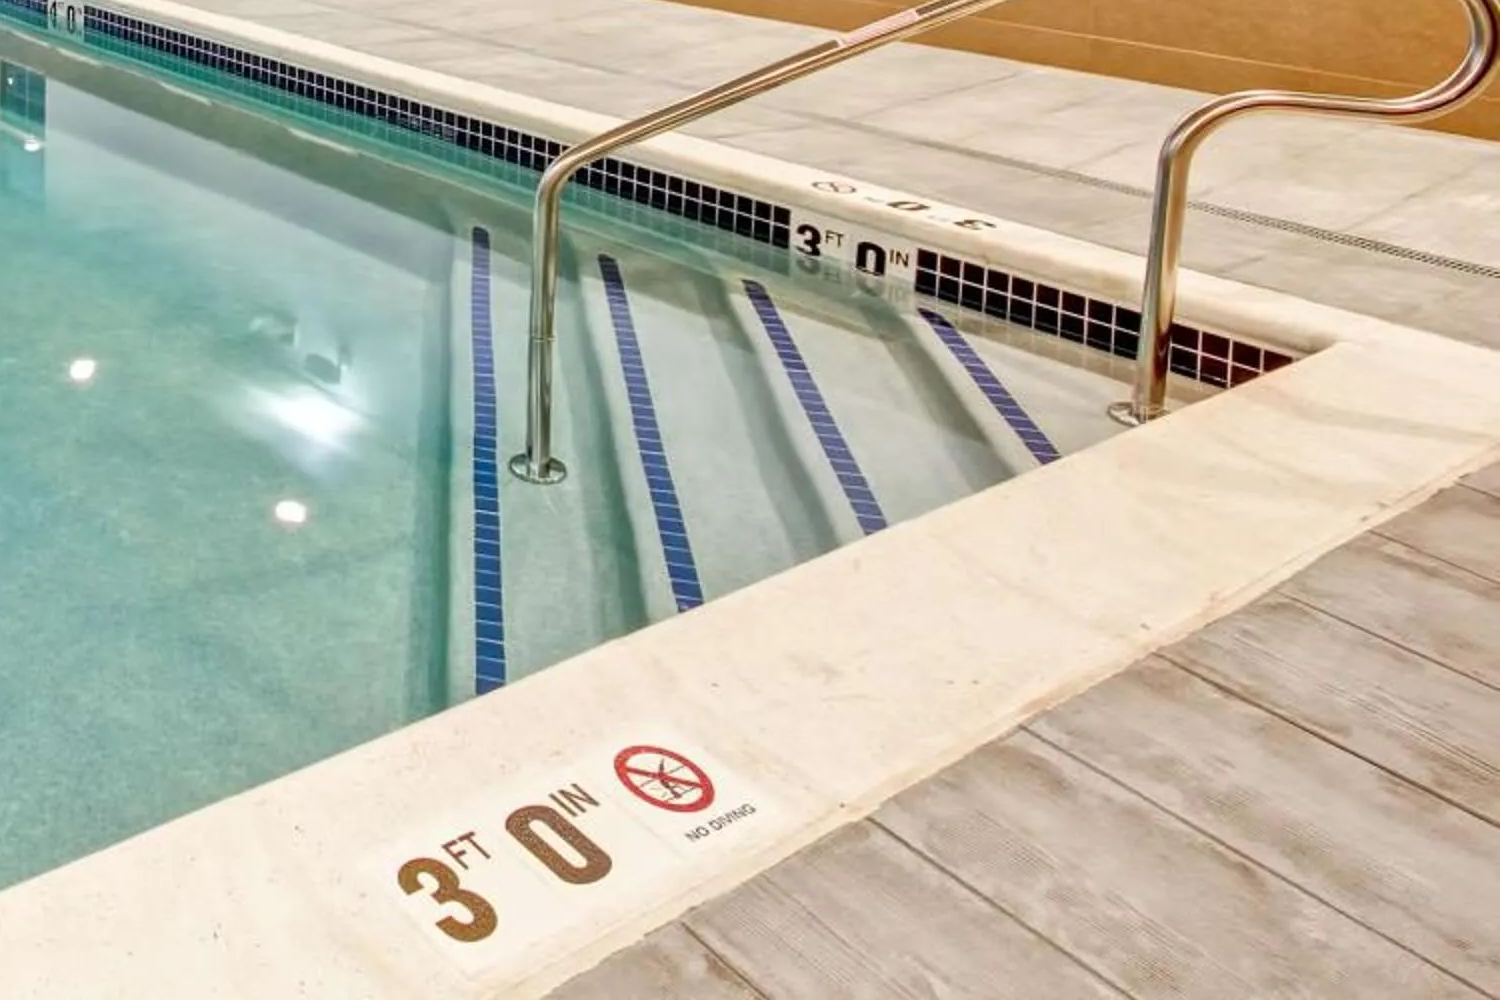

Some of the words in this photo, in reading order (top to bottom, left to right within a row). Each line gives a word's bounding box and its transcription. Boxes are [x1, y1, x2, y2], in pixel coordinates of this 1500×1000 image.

[796, 223, 823, 256] 3
[825, 230, 845, 247] FT
[855, 241, 886, 276] 0
[889, 249, 909, 268] IN
[549, 783, 601, 818] IN
[684, 826, 710, 842] NO
[708, 803, 757, 831] DIVING
[441, 831, 491, 870] FT
[505, 805, 613, 885] 0
[397, 857, 498, 943] 3
